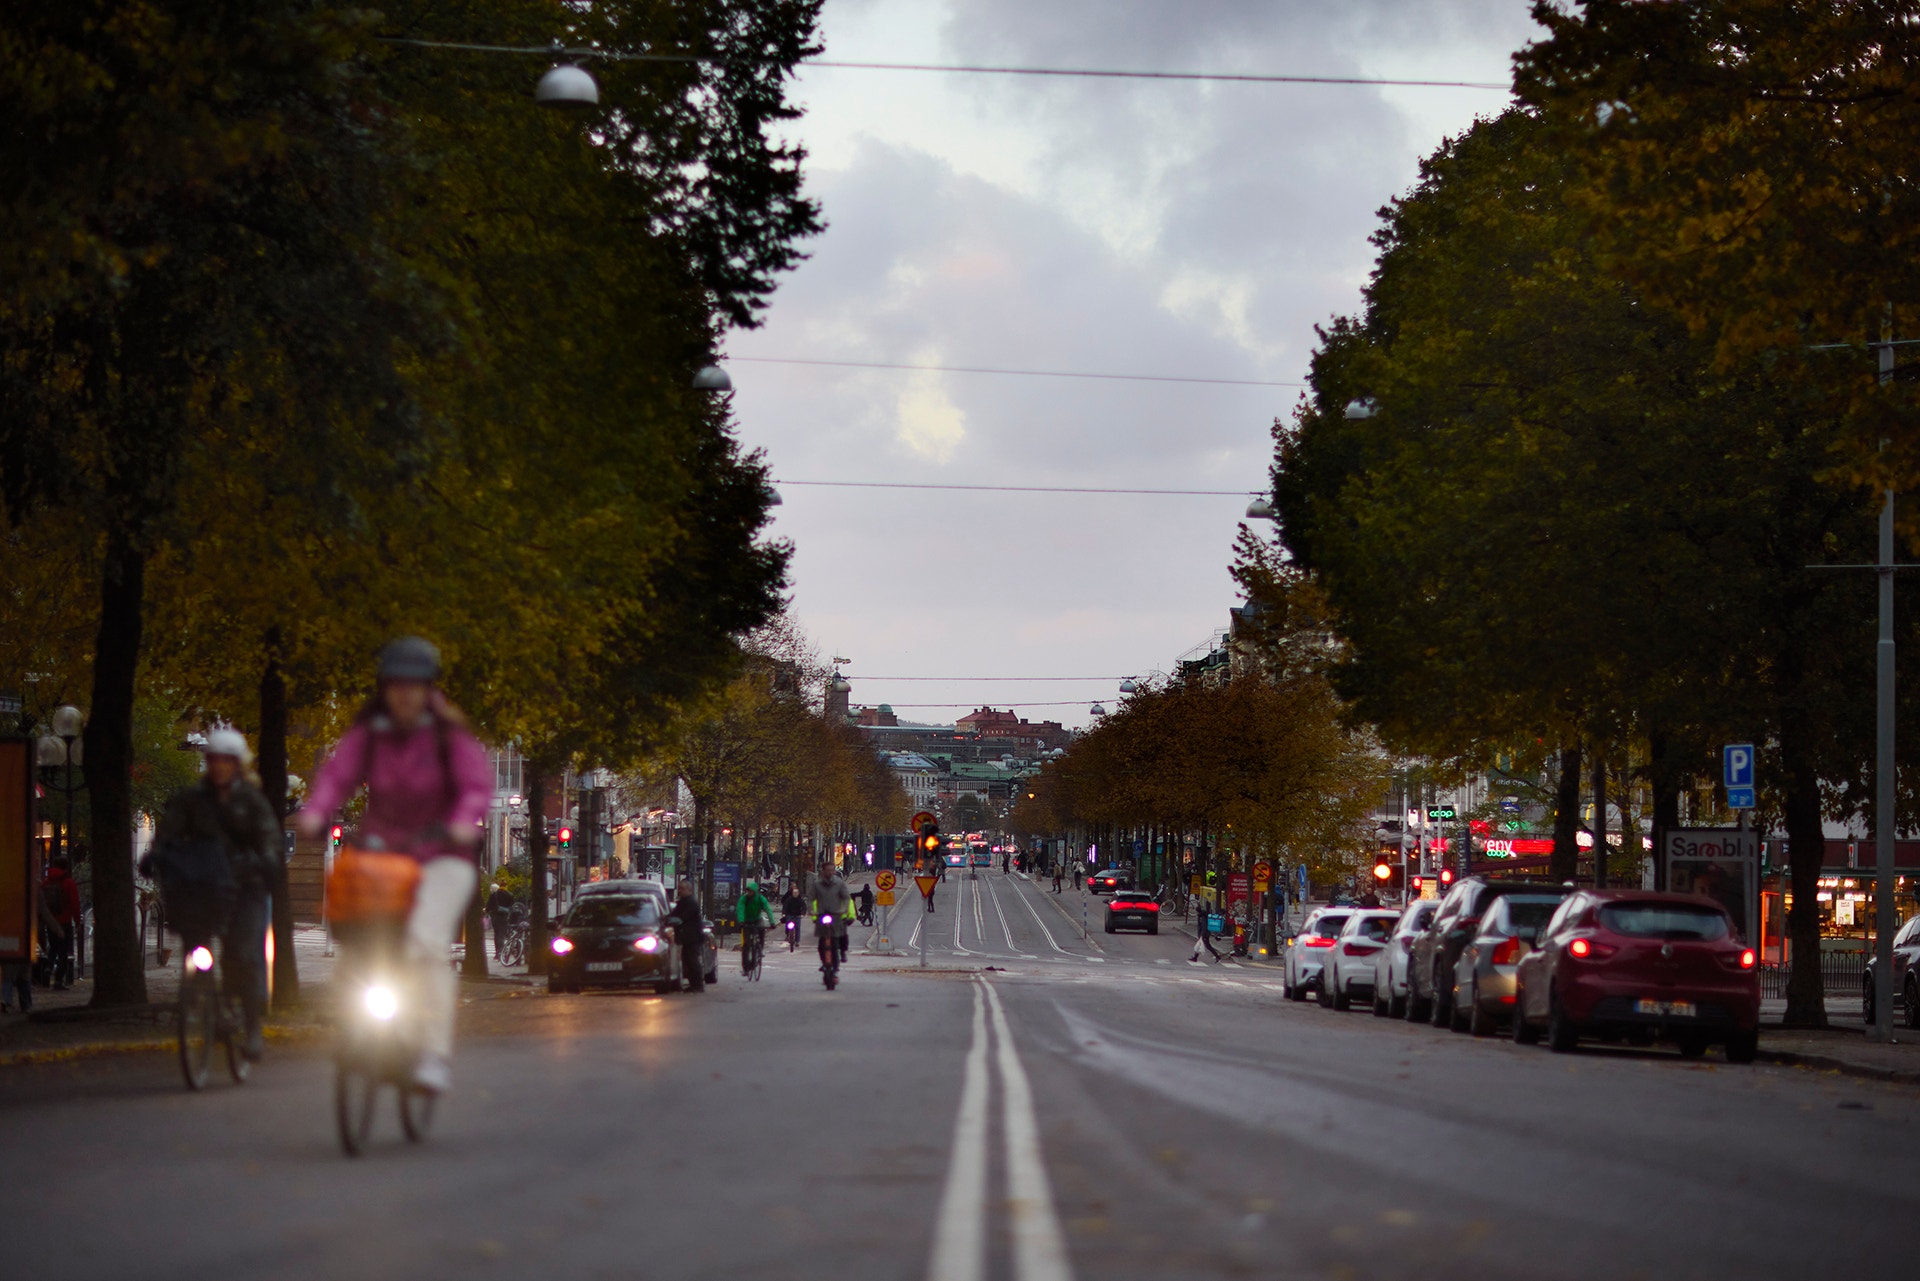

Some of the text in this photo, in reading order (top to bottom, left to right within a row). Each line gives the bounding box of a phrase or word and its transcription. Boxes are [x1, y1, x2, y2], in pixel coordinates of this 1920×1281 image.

[1730, 749, 1748, 782] P
[1429, 810, 1454, 819] coop
[1484, 839, 1513, 855] eny
[1486, 850, 1507, 859] coop
[1672, 837, 1754, 857] Sambl
